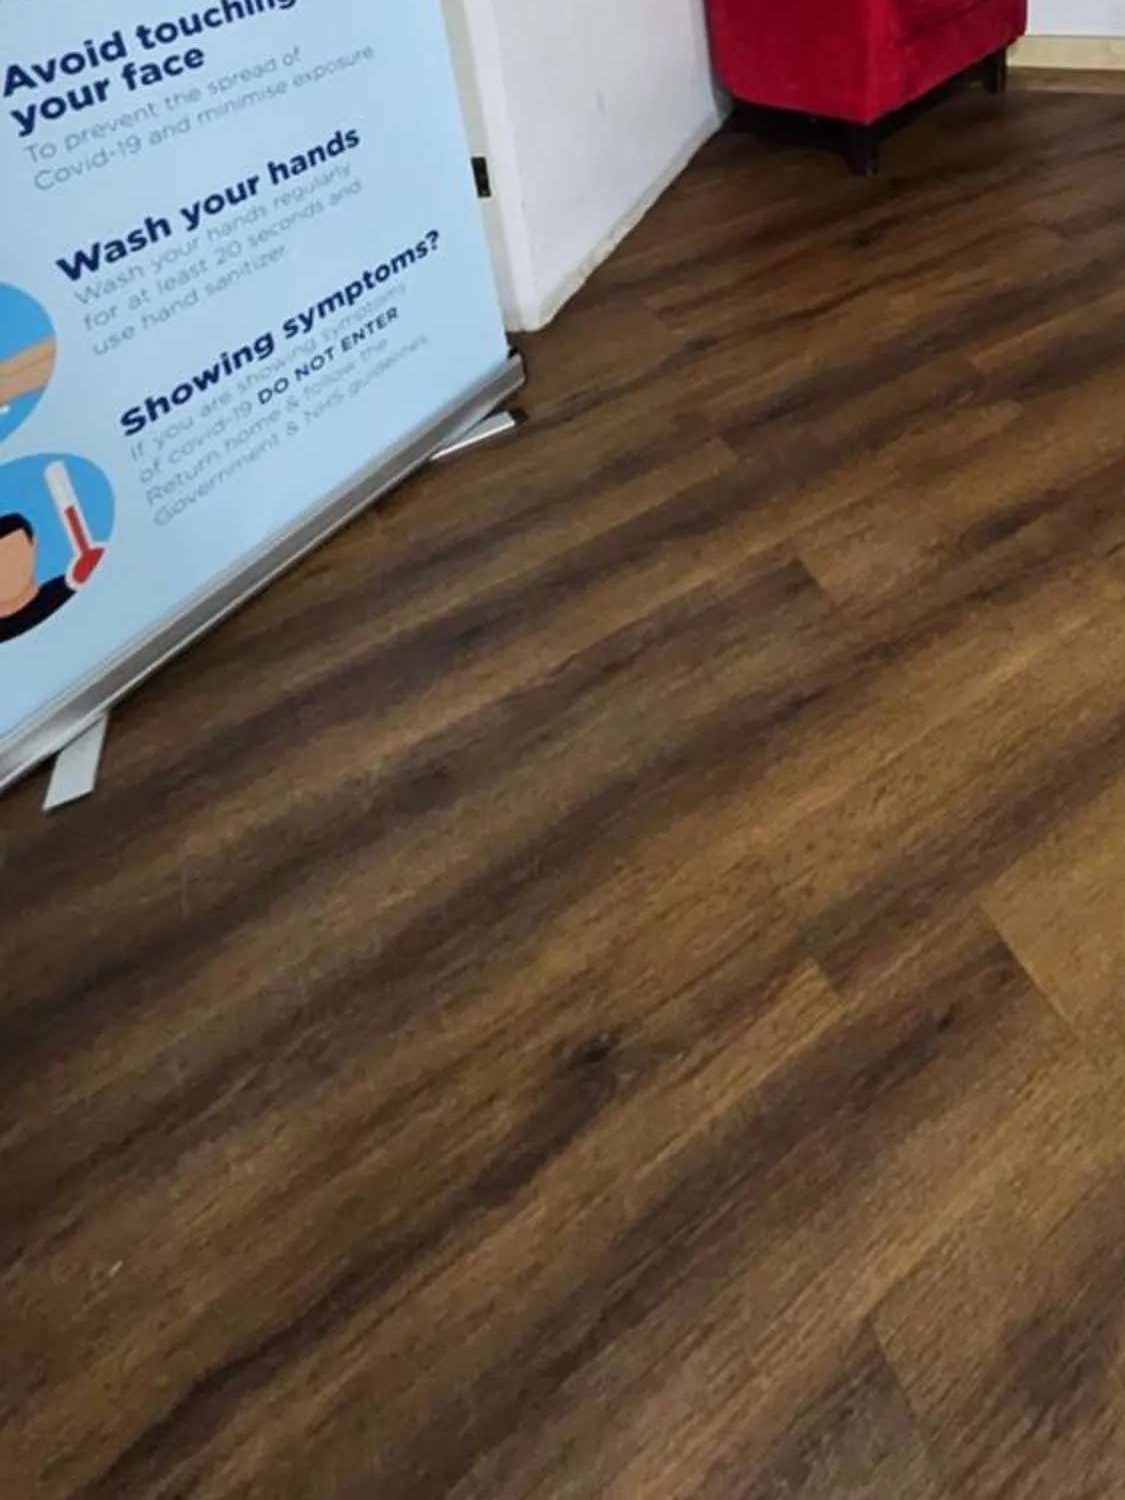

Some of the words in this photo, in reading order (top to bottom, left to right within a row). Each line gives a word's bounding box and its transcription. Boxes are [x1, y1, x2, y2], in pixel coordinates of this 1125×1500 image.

[3, 31, 128, 98] Avoid
[11, 78, 112, 138] your
[121, 48, 205, 91] face
[25, 138, 58, 164] To
[64, 102, 159, 155] prevent
[164, 88, 203, 113] the
[207, 55, 279, 102] spread
[33, 134, 142, 192] Covid-19
[149, 116, 192, 147] and
[197, 82, 289, 126] minimise
[292, 46, 375, 89] exposure
[55, 217, 172, 282] Wash
[180, 176, 259, 232] your
[267, 129, 361, 185] hands
[74, 262, 146, 305] Wash
[150, 235, 201, 273] your
[206, 204, 268, 242] hands
[84, 304, 118, 332] for
[127, 289, 152, 311] at
[156, 259, 209, 300] least
[215, 239, 243, 265] 20
[249, 198, 324, 247] seconds
[328, 178, 362, 208] and
[92, 326, 136, 357] use
[142, 290, 200, 330] hand
[120, 332, 275, 436] Showing
[282, 229, 440, 339] symptoms?
[257, 376, 289, 405] DO
[294, 347, 334, 382] NOT
[340, 306, 400, 352] ENTER
